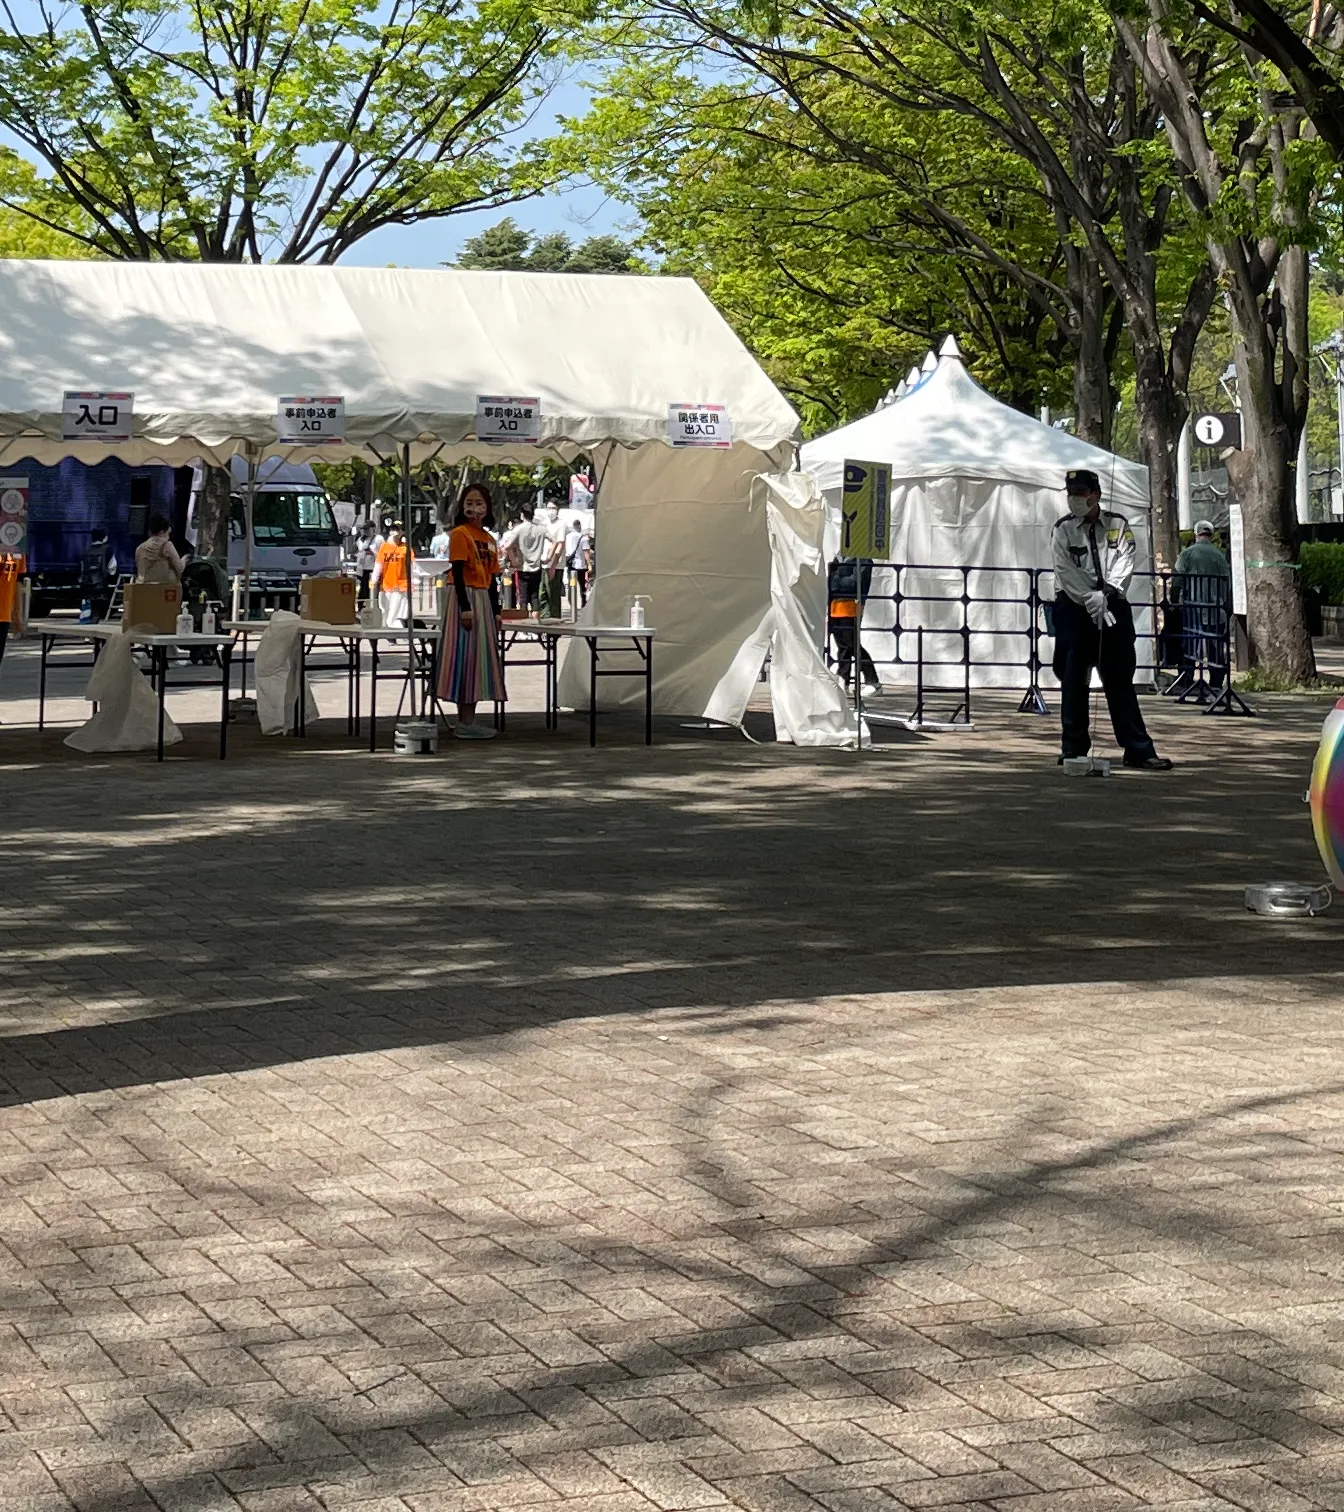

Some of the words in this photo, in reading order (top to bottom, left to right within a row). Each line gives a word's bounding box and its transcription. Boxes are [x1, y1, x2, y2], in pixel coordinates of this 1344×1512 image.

[75, 404, 118, 425] 入口
[300, 420, 321, 431] 入口
[498, 419, 518, 430] 入口
[684, 424, 716, 435] 出入口
